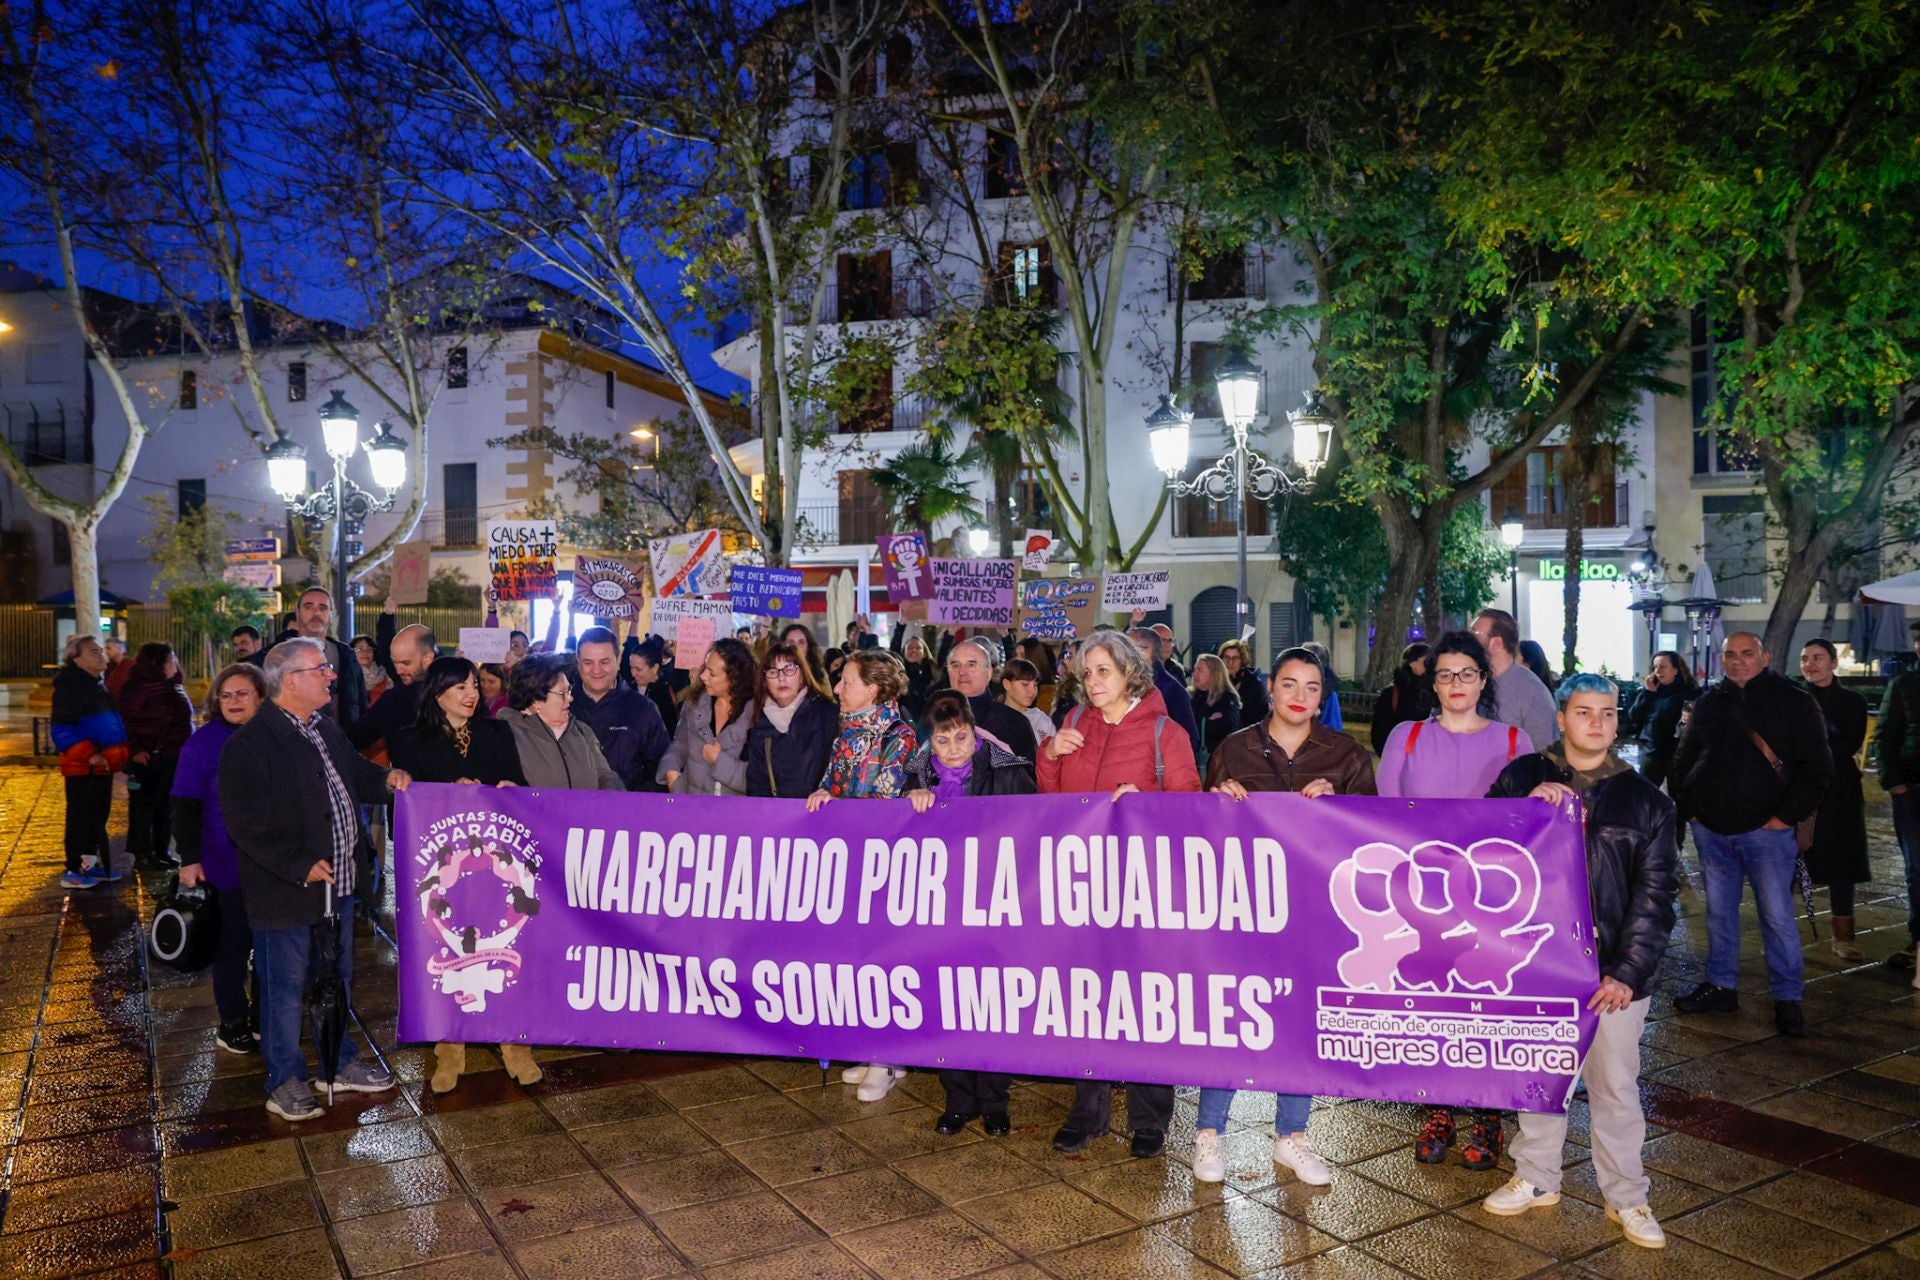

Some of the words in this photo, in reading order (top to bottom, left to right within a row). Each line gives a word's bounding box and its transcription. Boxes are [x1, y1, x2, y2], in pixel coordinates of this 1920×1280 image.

[491, 526, 537, 543] CAUSA
[540, 526, 554, 542] +
[488, 545, 525, 560] MIEDO
[528, 543, 557, 557] TENER
[489, 562, 509, 574] UNA
[512, 562, 555, 575] FEMINISTA
[592, 560, 629, 577] MIRARAS
[733, 570, 745, 579] ME
[748, 572, 765, 581] DICE
[950, 562, 1015, 579] CALLADAS
[492, 576, 512, 588] QUE
[732, 582, 744, 592] QUE
[746, 583, 755, 593] EL
[982, 578, 1014, 592] MUJERES
[1108, 574, 1128, 584] BASTA
[1130, 574, 1139, 583] DE
[598, 589, 619, 598] OJOS
[1024, 580, 1054, 604] NO
[940, 606, 948, 620] Y
[952, 606, 1013, 623] DECIDIDAS!
[430, 811, 486, 835] JUNTAS
[489, 812, 532, 839] SOMOS
[414, 823, 544, 868] IMPARABLES
[564, 827, 849, 925] MARCHANDO
[857, 836, 949, 927] POR
[962, 836, 1023, 927] LA
[1039, 834, 1289, 934] IGUALDAD
[501, 952, 518, 960] MUJER
[565, 944, 742, 1019] “JUNTAS
[751, 959, 923, 1031] SOMOS
[937, 965, 1293, 1051] IMPARABLES”
[1320, 1013, 1401, 1031] Federación
[1406, 1018, 1425, 1032] de
[1431, 1021, 1549, 1037] organizaciones
[1555, 1024, 1576, 1038] de
[1320, 1034, 1436, 1065] mujeres
[1446, 1038, 1482, 1064] de
[1495, 1041, 1576, 1071] Lorca
